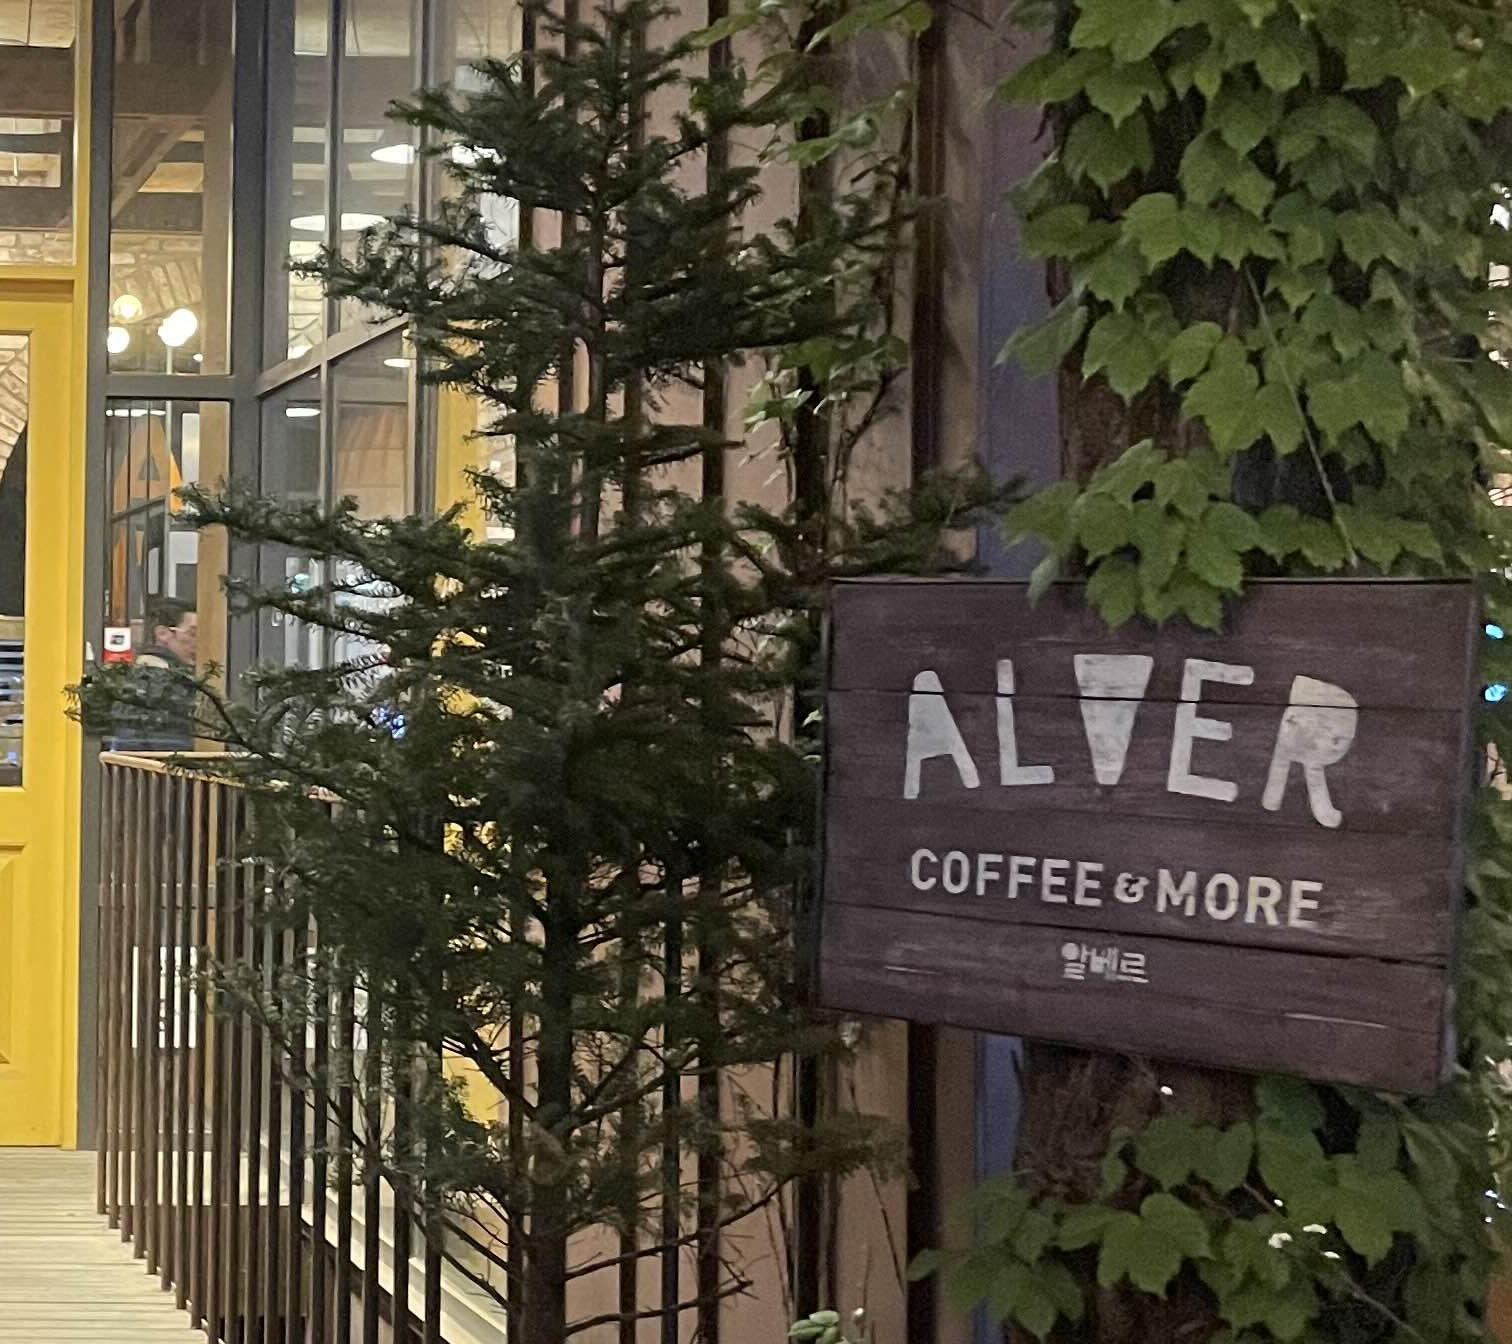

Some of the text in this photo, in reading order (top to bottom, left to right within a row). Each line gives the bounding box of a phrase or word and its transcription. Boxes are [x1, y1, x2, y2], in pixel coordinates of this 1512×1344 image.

[903, 654, 1359, 829] ALVER
[909, 847, 1104, 908] COFFEE
[1155, 867, 1324, 930] MORE
